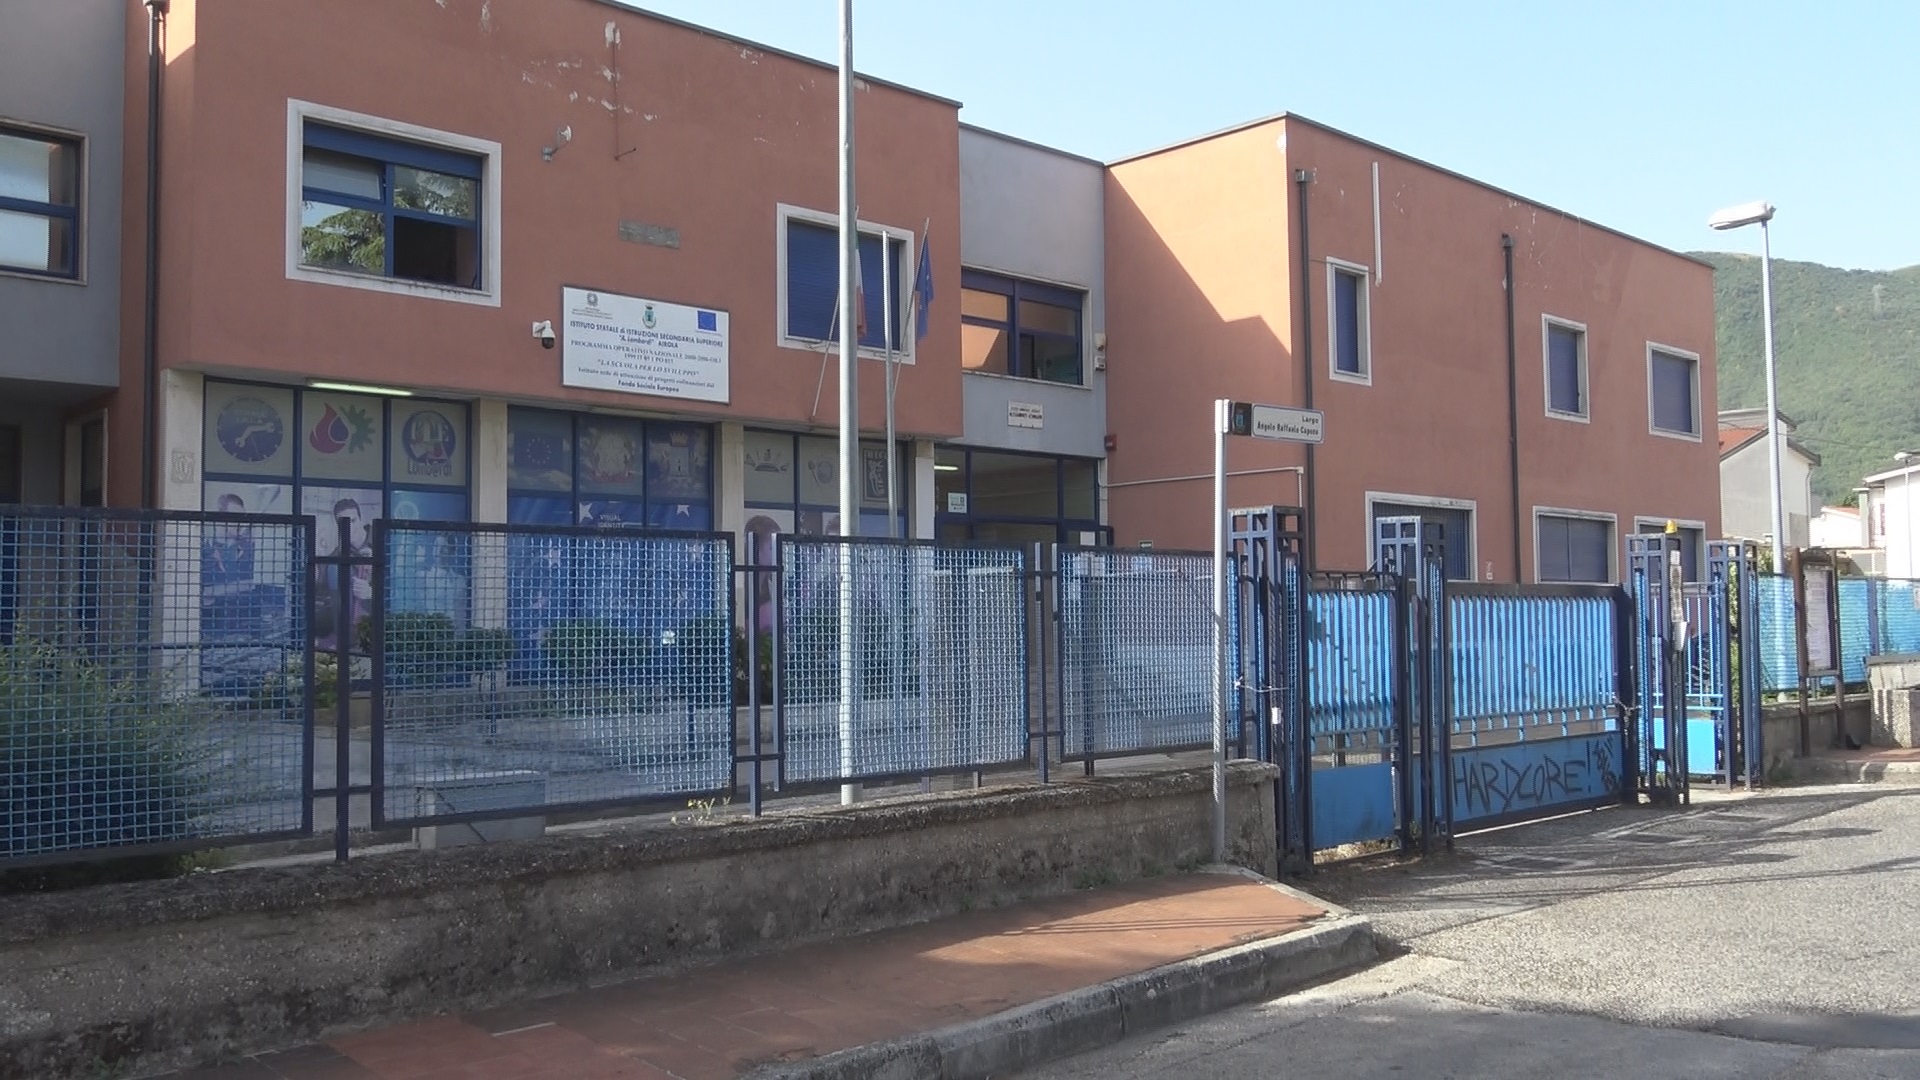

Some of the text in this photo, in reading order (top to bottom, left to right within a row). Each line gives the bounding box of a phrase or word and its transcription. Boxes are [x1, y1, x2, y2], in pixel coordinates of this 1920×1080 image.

[570, 320, 596, 330] ISTITUTO
[596, 323, 619, 334] STATALE
[620, 326, 626, 334] di
[626, 327, 659, 339] ISTRUZIONE
[660, 331, 695, 344] SECONDARIA
[696, 336, 724, 348] SUPERIORE
[571, 339, 613, 351] PROGRAMMA
[613, 344, 649, 355] OPERATIVO
[649, 349, 684, 360] NAZIONALE
[658, 340, 679, 349] AIROLA
[611, 360, 638, 370] SCUOLA
[618, 379, 680, 393] Fondo Sociale Europeo
[1302, 415, 1319, 425] Largo
[1257, 421, 1319, 436] Angelo Raffaele Capone
